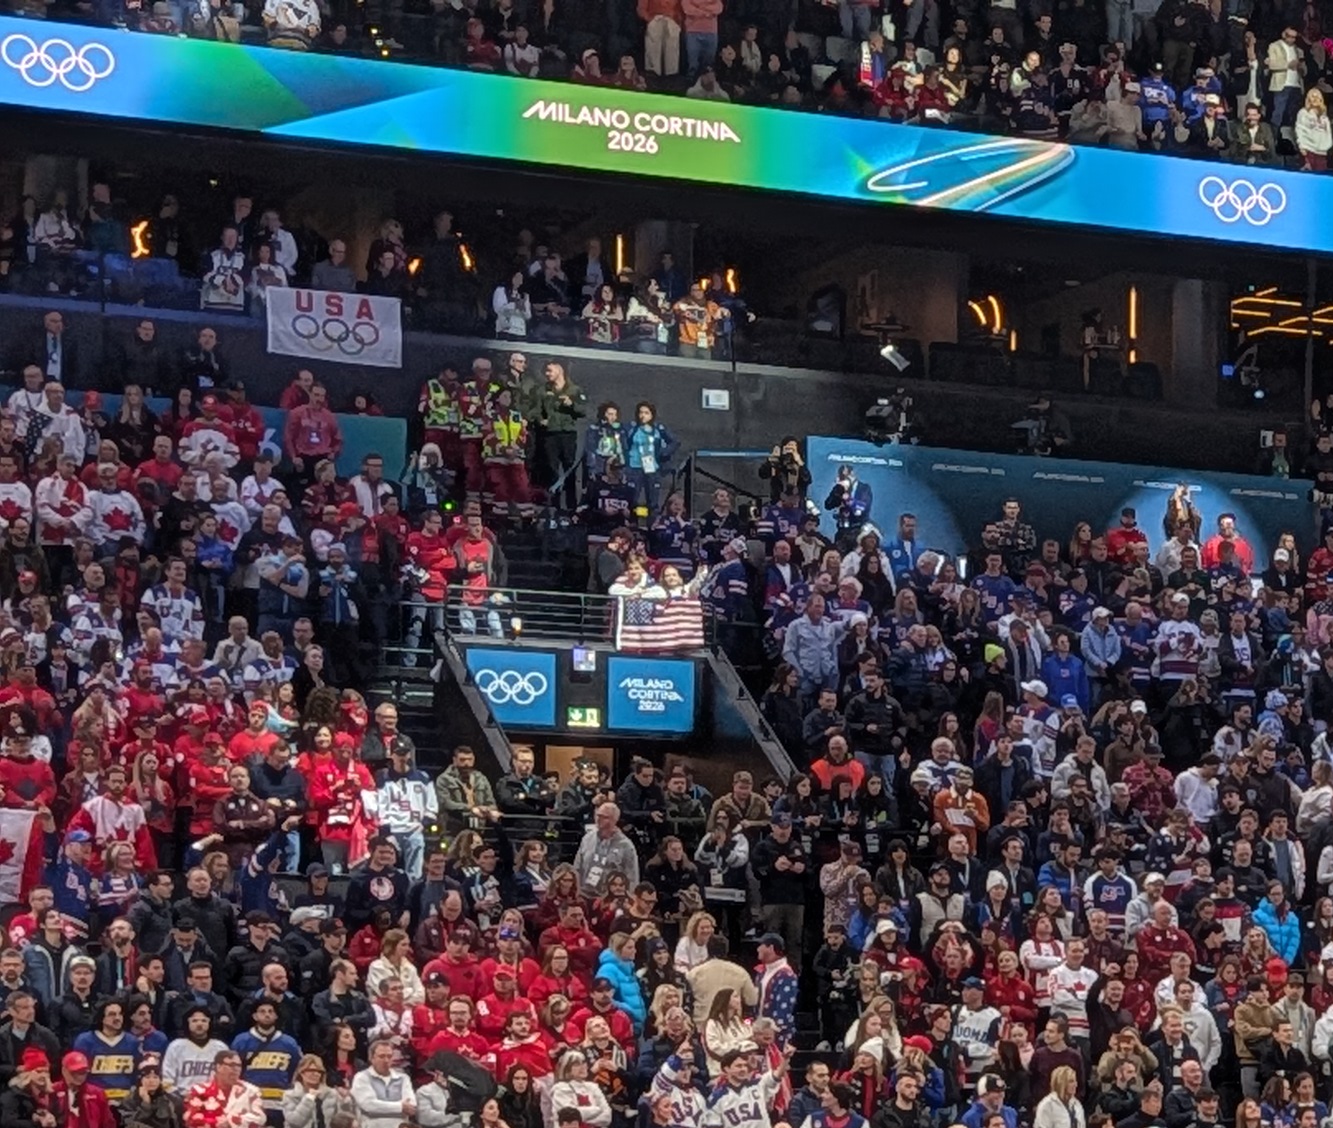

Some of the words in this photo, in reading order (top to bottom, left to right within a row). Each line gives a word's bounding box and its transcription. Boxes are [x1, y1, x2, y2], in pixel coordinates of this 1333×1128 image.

[522, 100, 630, 129] MILANO
[634, 112, 741, 143] CORTINA
[607, 130, 659, 154] 2026
[295, 290, 374, 321] USA
[618, 677, 673, 690] MILANO
[91, 1055, 134, 1075] CHIEFS
[181, 1060, 215, 1077] CHIEF
[724, 1102, 763, 1126] USA
